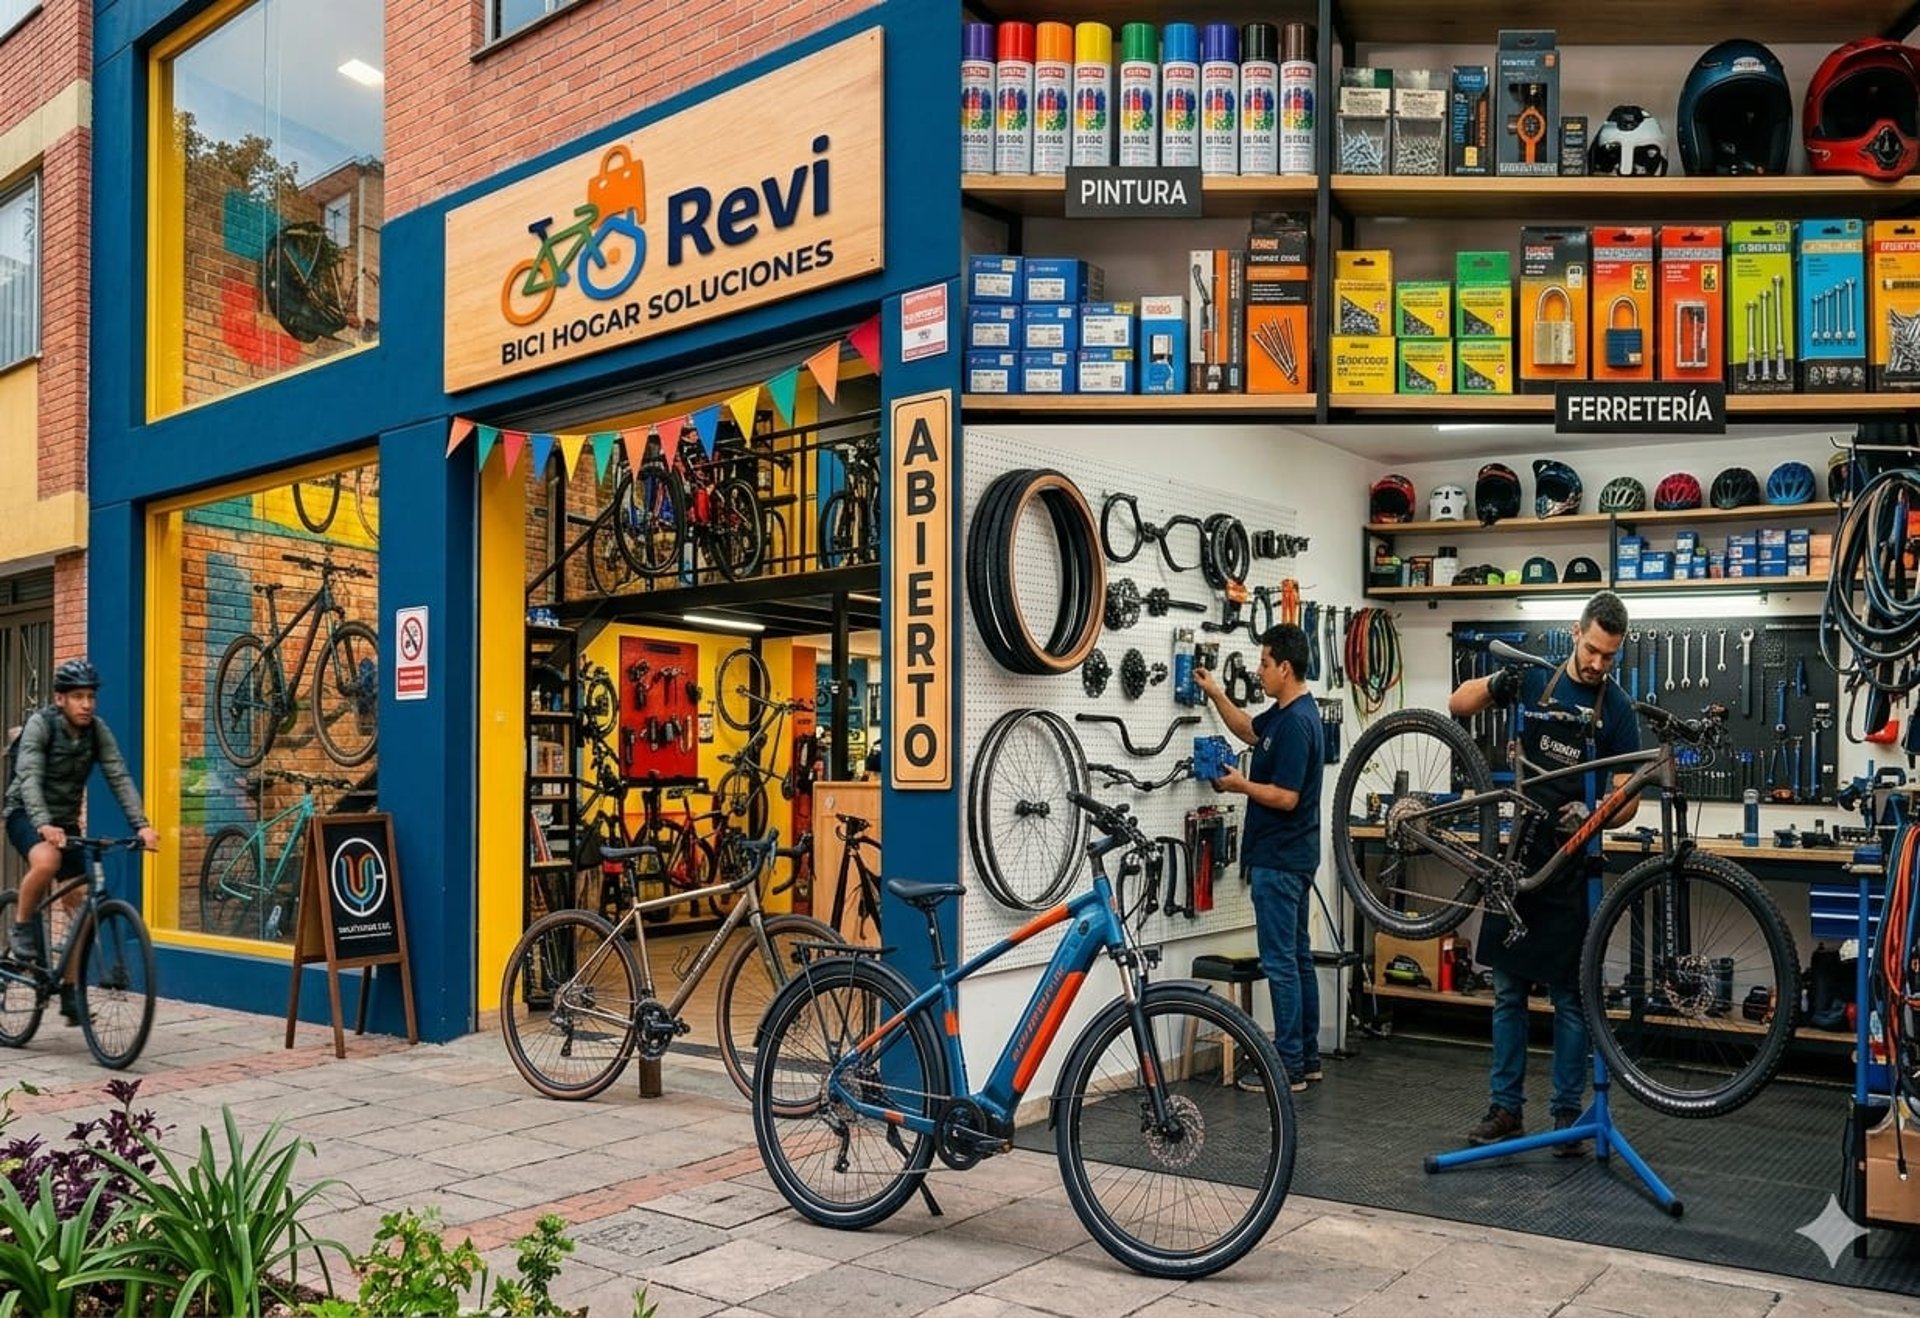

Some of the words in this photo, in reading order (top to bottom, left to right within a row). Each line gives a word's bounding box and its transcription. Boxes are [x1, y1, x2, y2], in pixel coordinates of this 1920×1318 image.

[667, 134, 830, 266] Revi
[1081, 179, 1188, 205] PINTURA
[501, 331, 545, 365] BICI
[554, 302, 640, 347] HOGAR
[650, 240, 834, 319] SOLUCIONES
[1567, 389, 1713, 422] FERRETERÍA
[903, 417, 939, 767] ABIERTO
